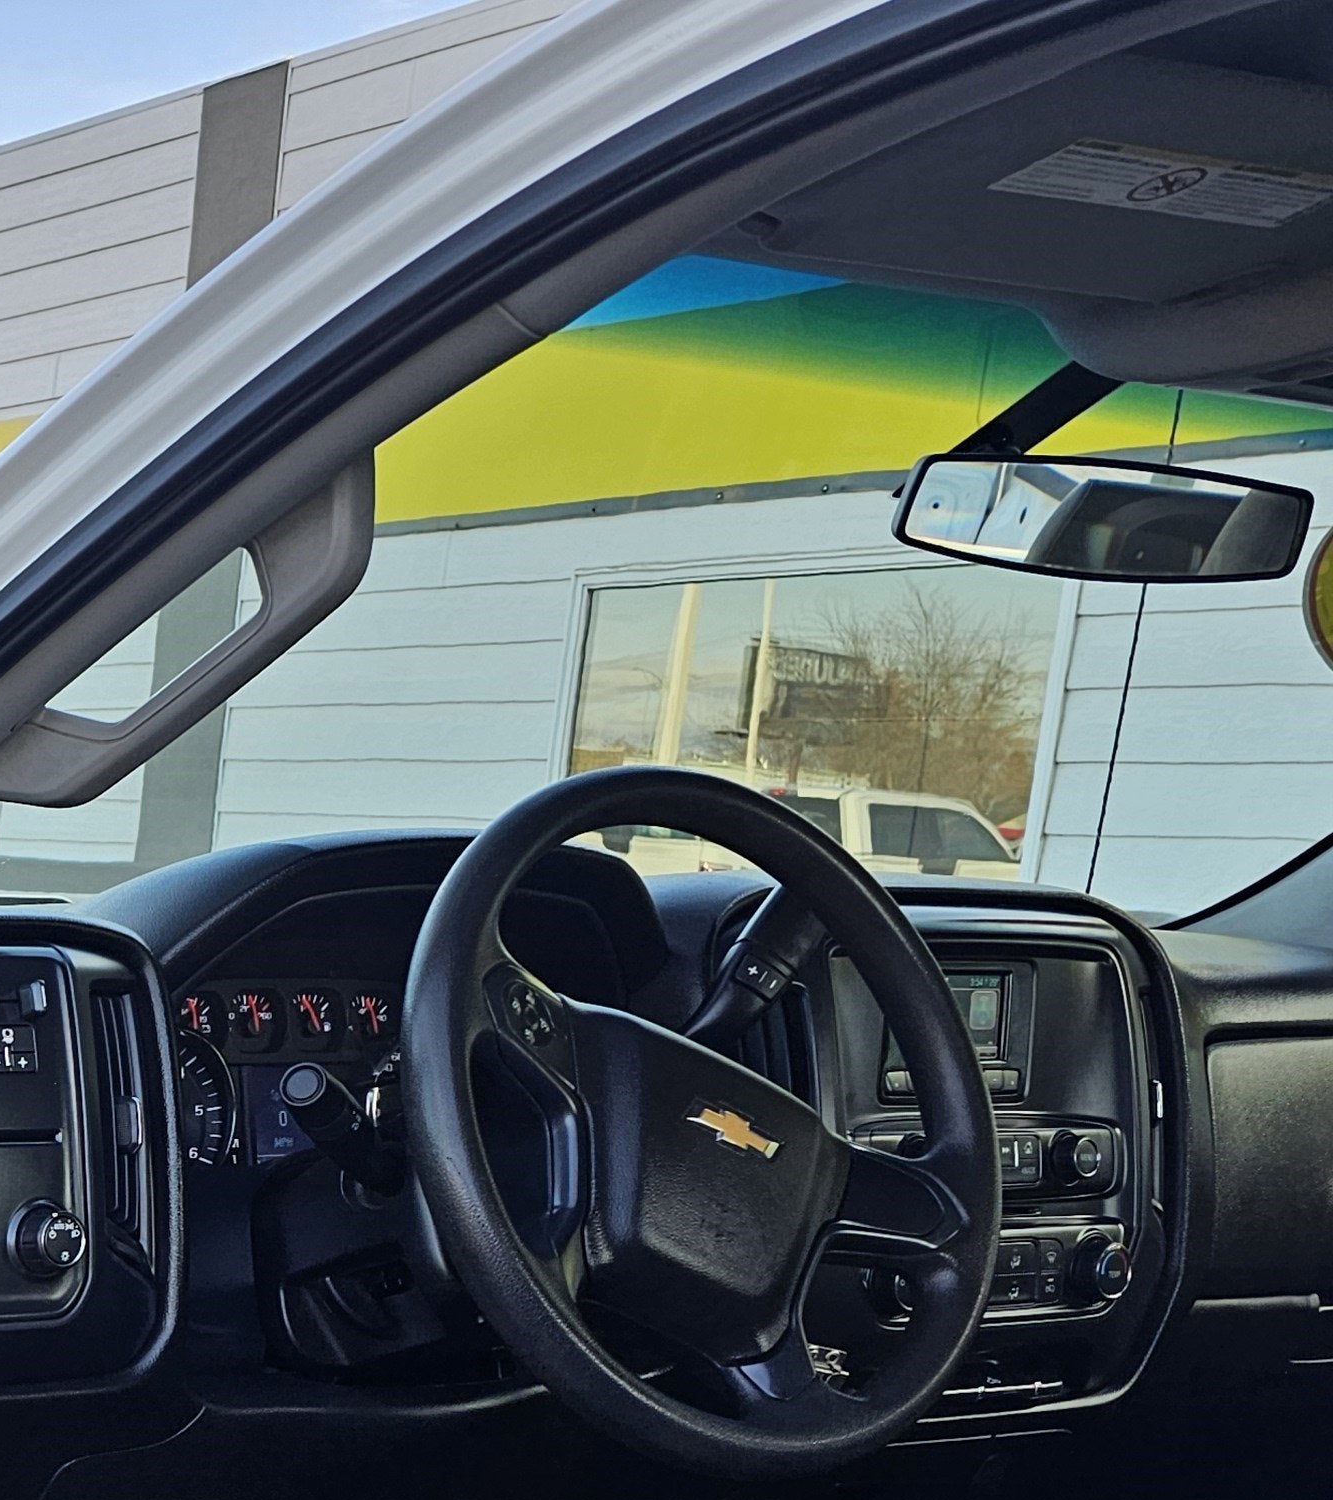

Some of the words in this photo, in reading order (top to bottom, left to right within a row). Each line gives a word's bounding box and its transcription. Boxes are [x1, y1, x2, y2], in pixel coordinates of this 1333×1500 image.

[194, 1104, 204, 1116] 5
[278, 1110, 288, 1127] 0
[188, 1147, 199, 1159] 6
